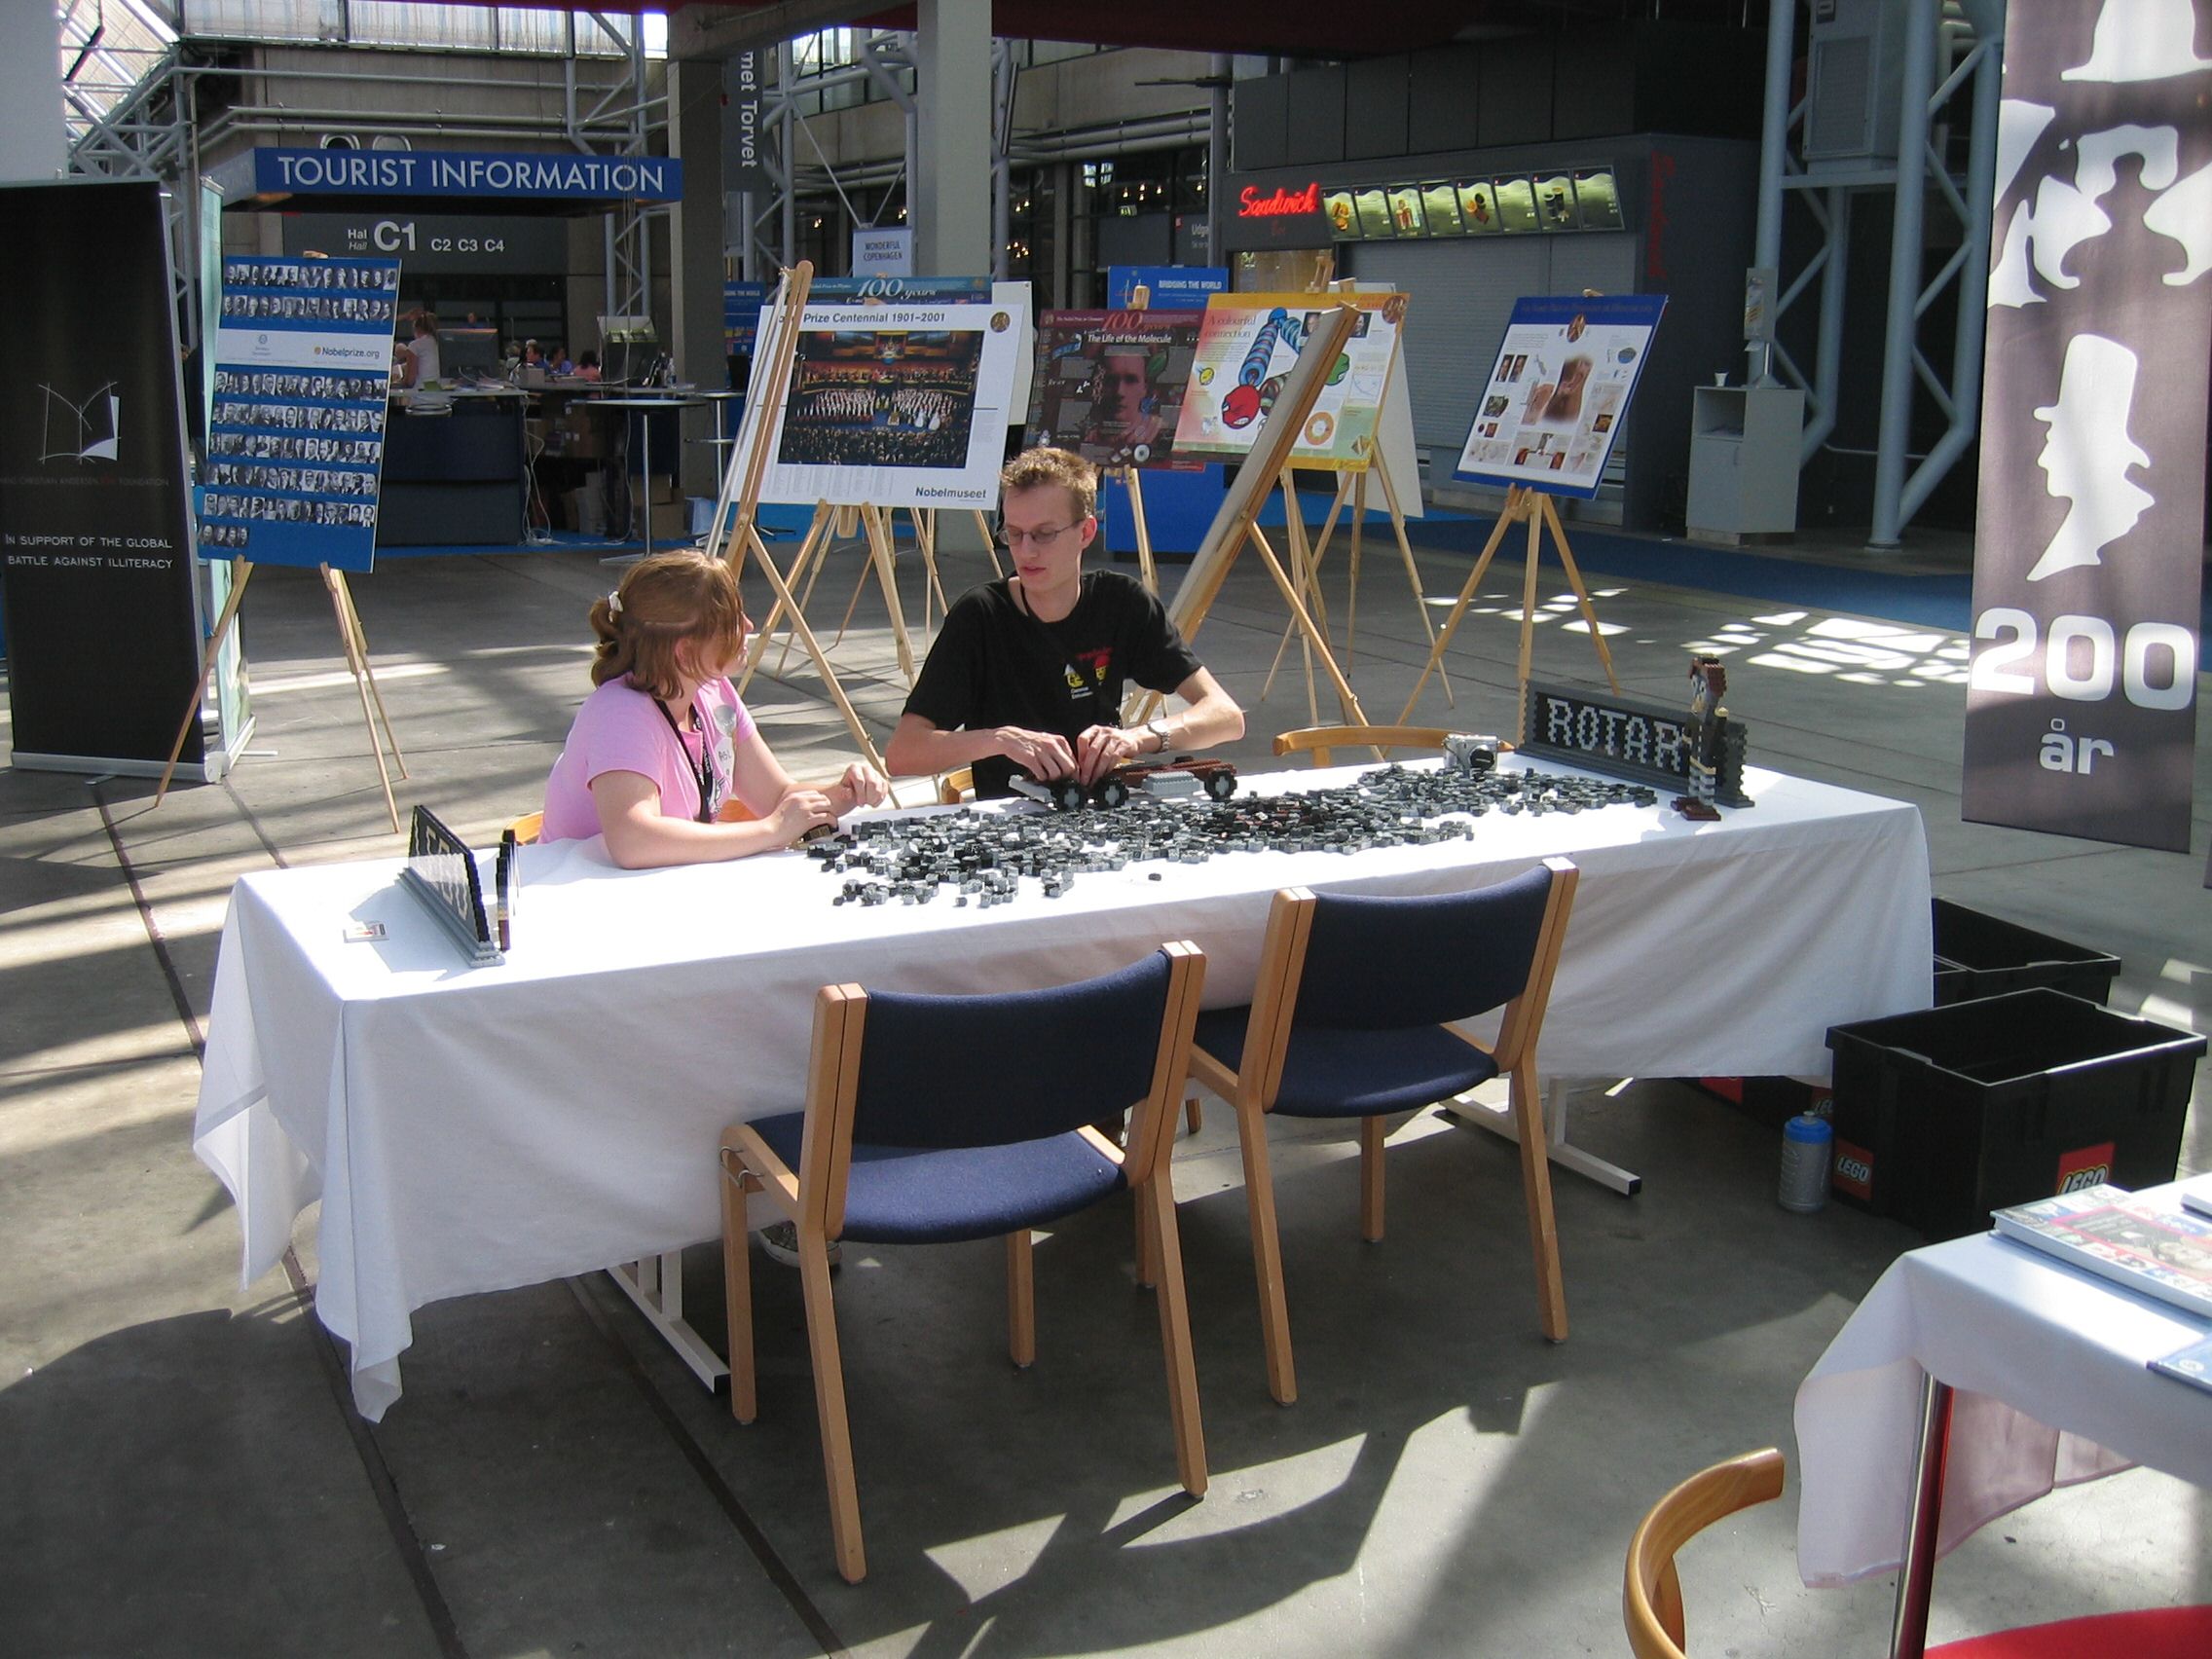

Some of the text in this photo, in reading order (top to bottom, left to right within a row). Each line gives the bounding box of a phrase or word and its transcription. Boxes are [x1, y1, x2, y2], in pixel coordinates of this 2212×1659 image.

[740, 99, 758, 168] Torvet
[276, 156, 664, 193] TOURIST INFORMATION
[1237, 181, 1321, 218] Sandwich
[347, 220, 417, 252] Hal C1
[348, 240, 368, 251] Hall
[430, 239, 506, 253] C2 C3 C4
[865, 240, 901, 251] WONDERFUL
[863, 250, 903, 262] COPENHAGEN
[856, 278, 904, 298] 100
[802, 312, 830, 323] Prize
[832, 312, 888, 323] Centennial
[1102, 312, 1144, 332] 100
[1088, 334, 1172, 344] The Life of the Molecule
[322, 348, 380, 359] Nobelprize.org
[915, 487, 987, 499] Nobelmuseet
[19, 535, 75, 546] SUPPORT
[79, 535, 95, 547] OF
[100, 536, 123, 547] THE
[126, 537, 173, 549] GLOBAL
[7, 555, 173, 569] BATTLE AGAINST ILLITERACY
[1971, 607, 2195, 712] 200
[2039, 718, 2115, 775] år
[1837, 1156, 1870, 1183] LEGO
